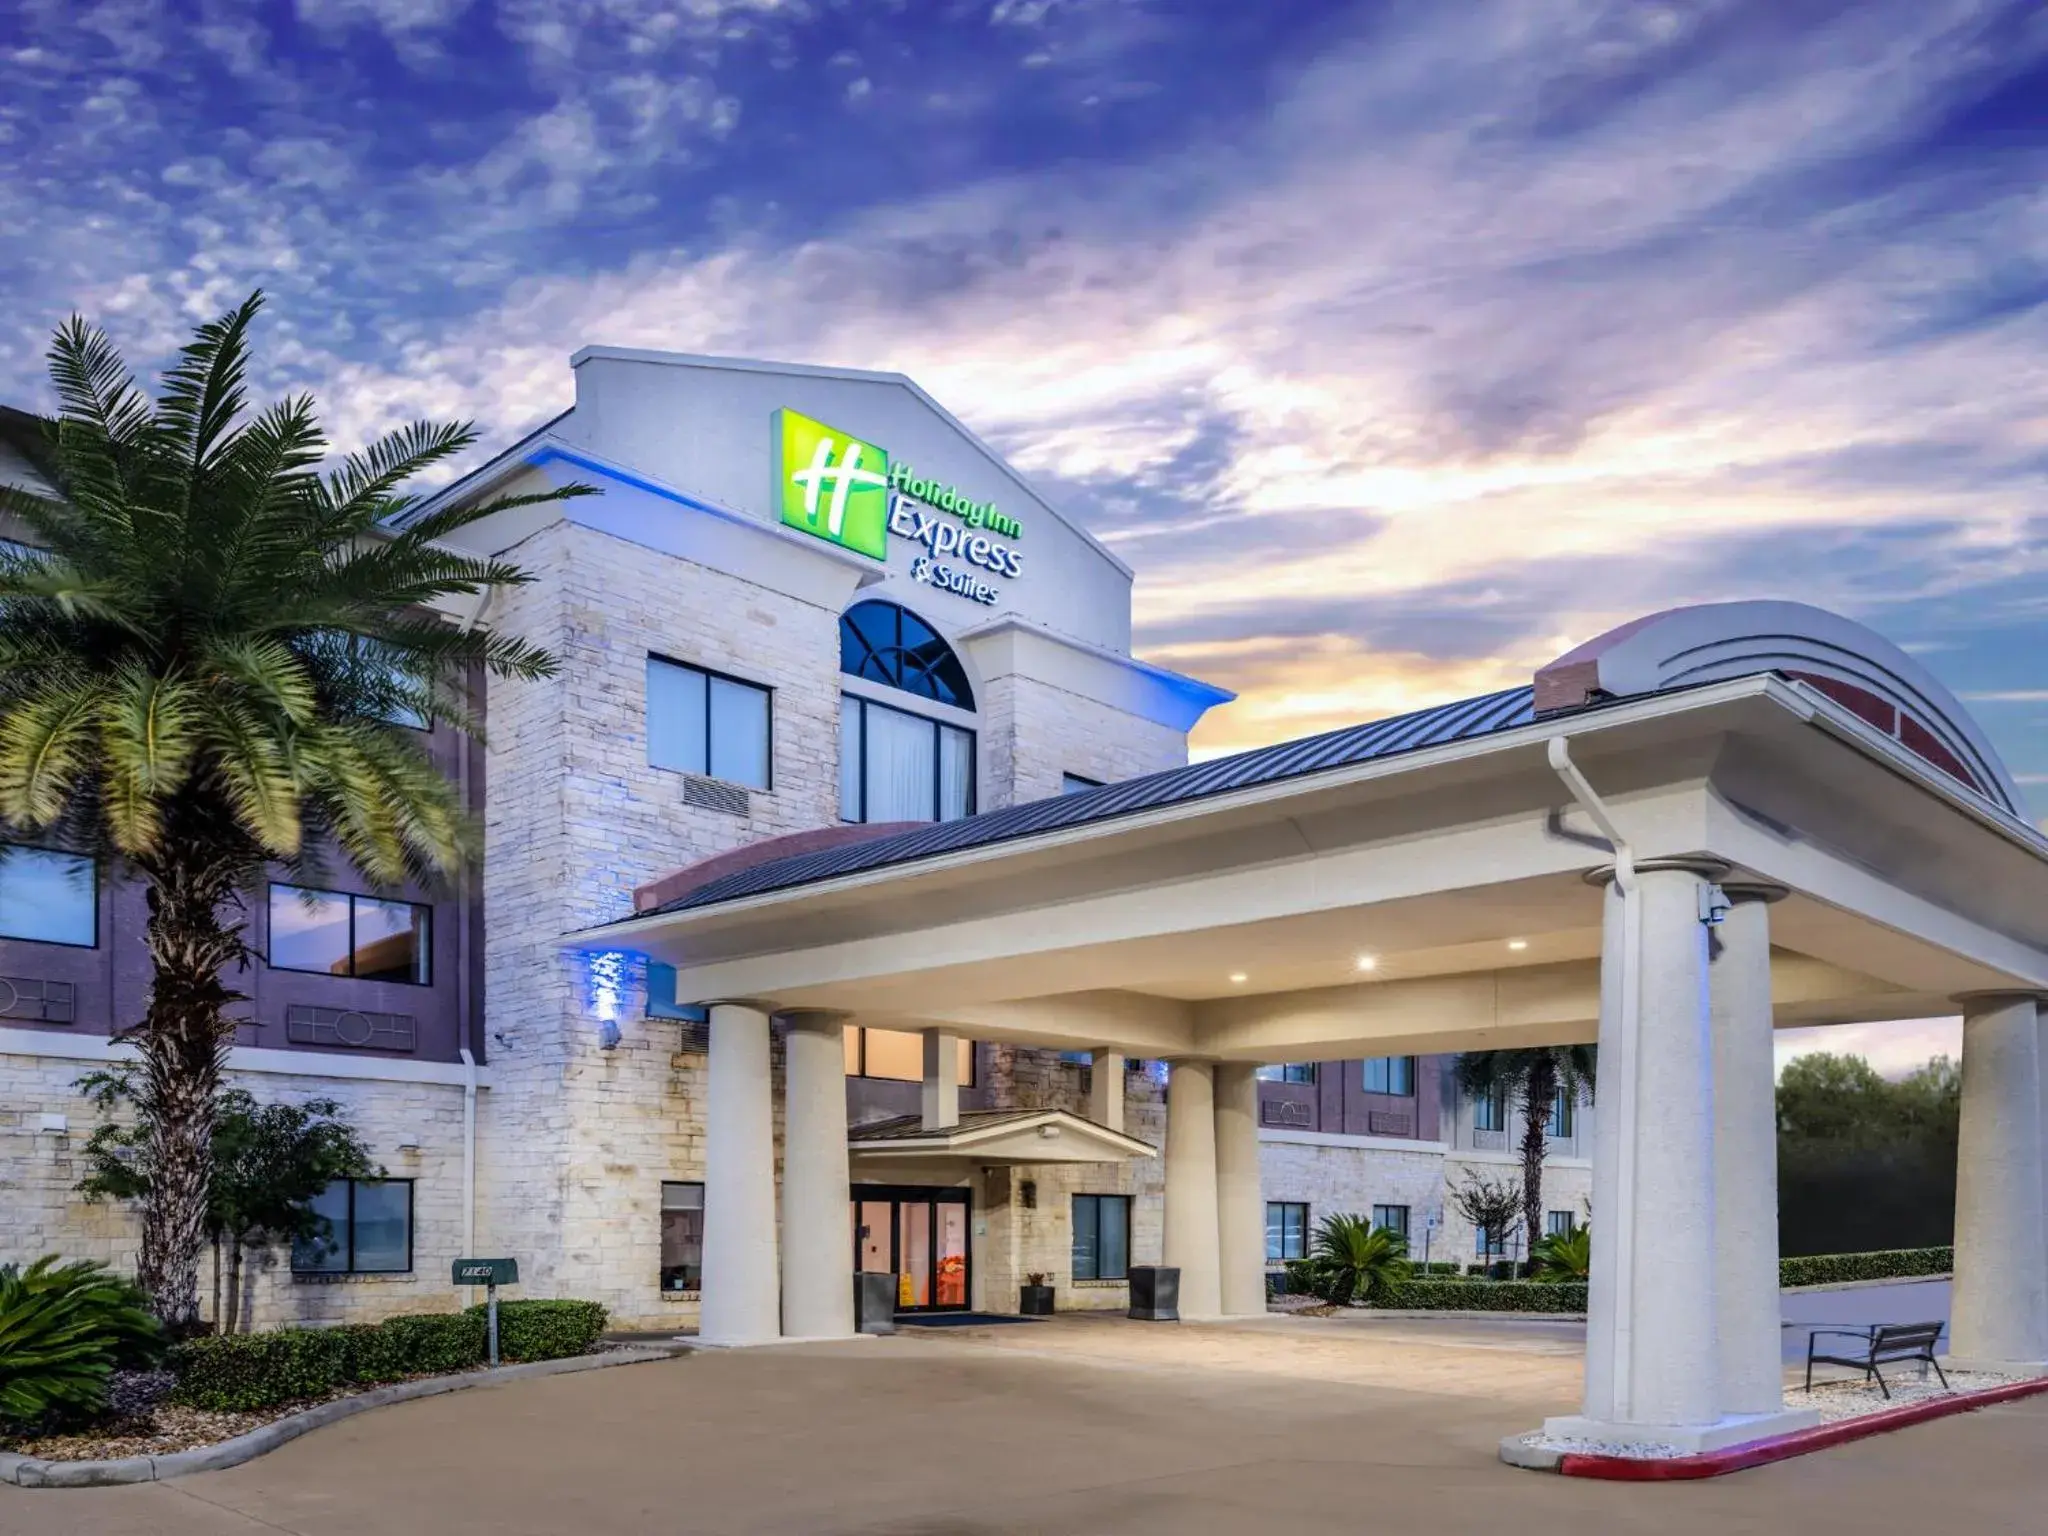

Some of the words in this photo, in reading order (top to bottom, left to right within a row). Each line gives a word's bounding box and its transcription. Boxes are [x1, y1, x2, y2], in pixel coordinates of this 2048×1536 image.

[888, 461, 986, 528] Holiday
[987, 505, 1023, 539] Inn
[888, 494, 1023, 578] Express
[911, 556, 932, 583] &
[932, 564, 999, 606] Suites
